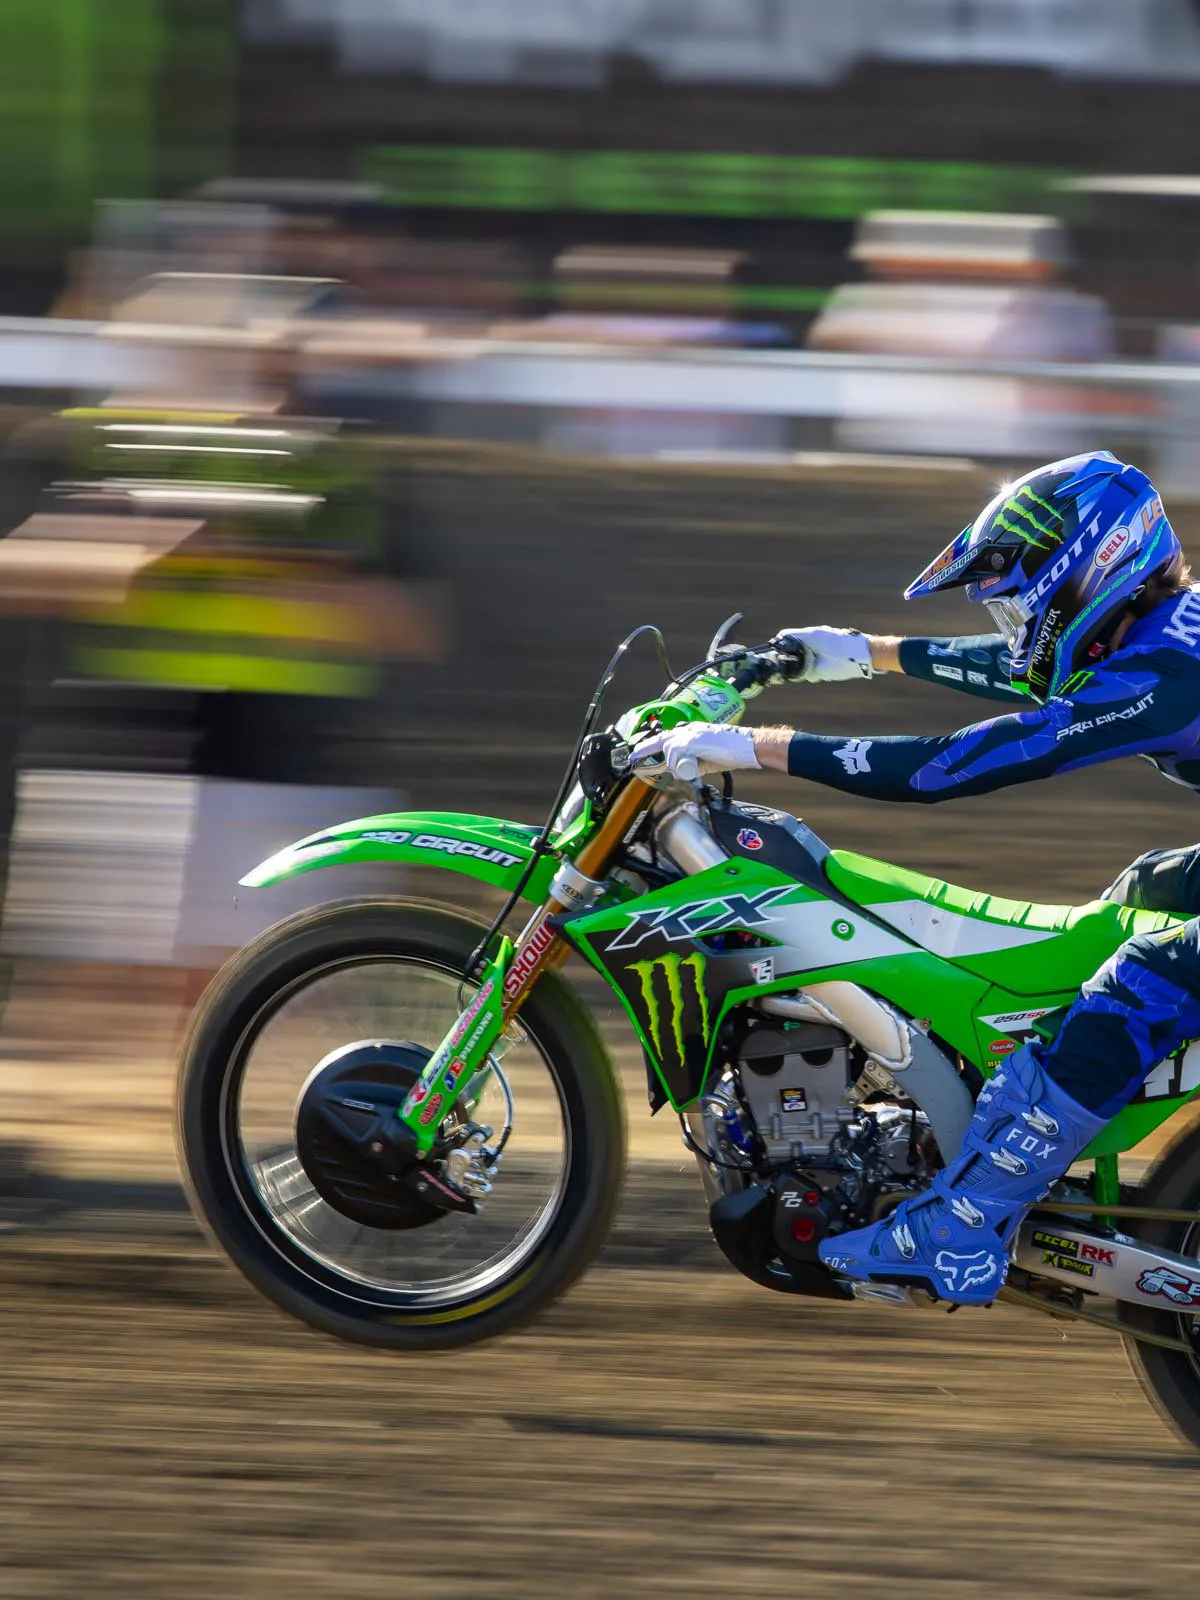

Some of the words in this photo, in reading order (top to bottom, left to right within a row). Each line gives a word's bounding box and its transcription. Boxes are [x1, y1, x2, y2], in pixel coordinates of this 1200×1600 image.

[1023, 511, 1102, 613] SCOTT
[1097, 532, 1127, 563] BELL
[1032, 608, 1061, 665] MONSTER
[1056, 721, 1094, 741] PRO
[1095, 692, 1155, 726] CIRCUIT
[411, 835, 524, 867] CIRCUIT
[605, 884, 803, 951] KX
[443, 1055, 467, 1092] JE
[459, 1011, 494, 1061] PISTONS
[1005, 1127, 1057, 1159] FOX
[780, 1191, 803, 1208] PC
[1034, 1232, 1077, 1251] EXCEL
[1081, 1243, 1116, 1265] RK
